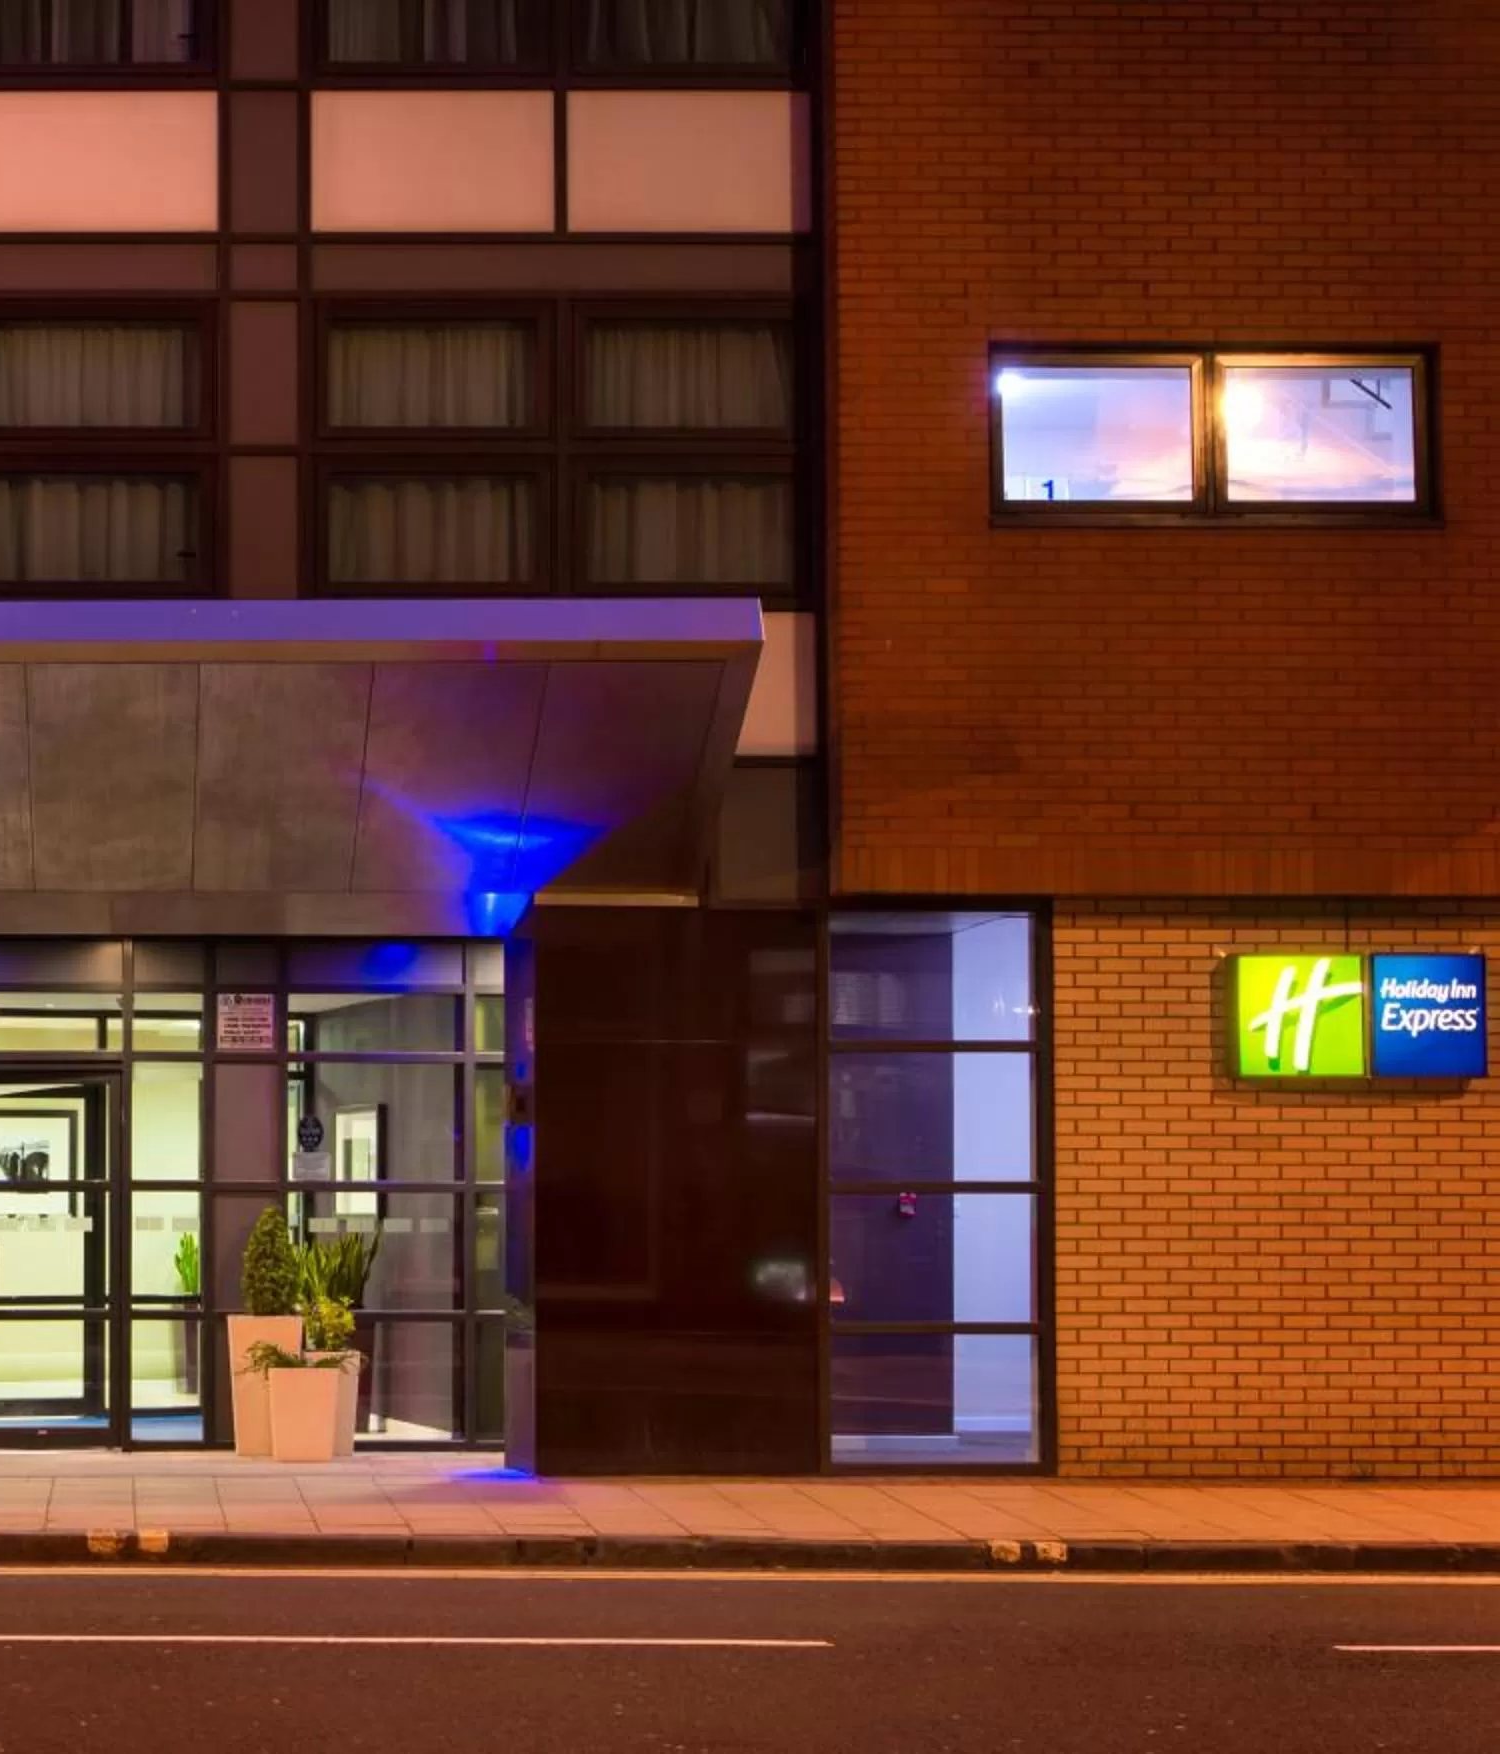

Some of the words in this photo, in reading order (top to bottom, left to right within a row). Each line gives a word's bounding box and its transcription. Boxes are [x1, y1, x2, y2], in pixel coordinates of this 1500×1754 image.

[1380, 977, 1449, 1004] Holiday
[1450, 977, 1477, 999] Inn
[1381, 1002, 1477, 1037] Express
